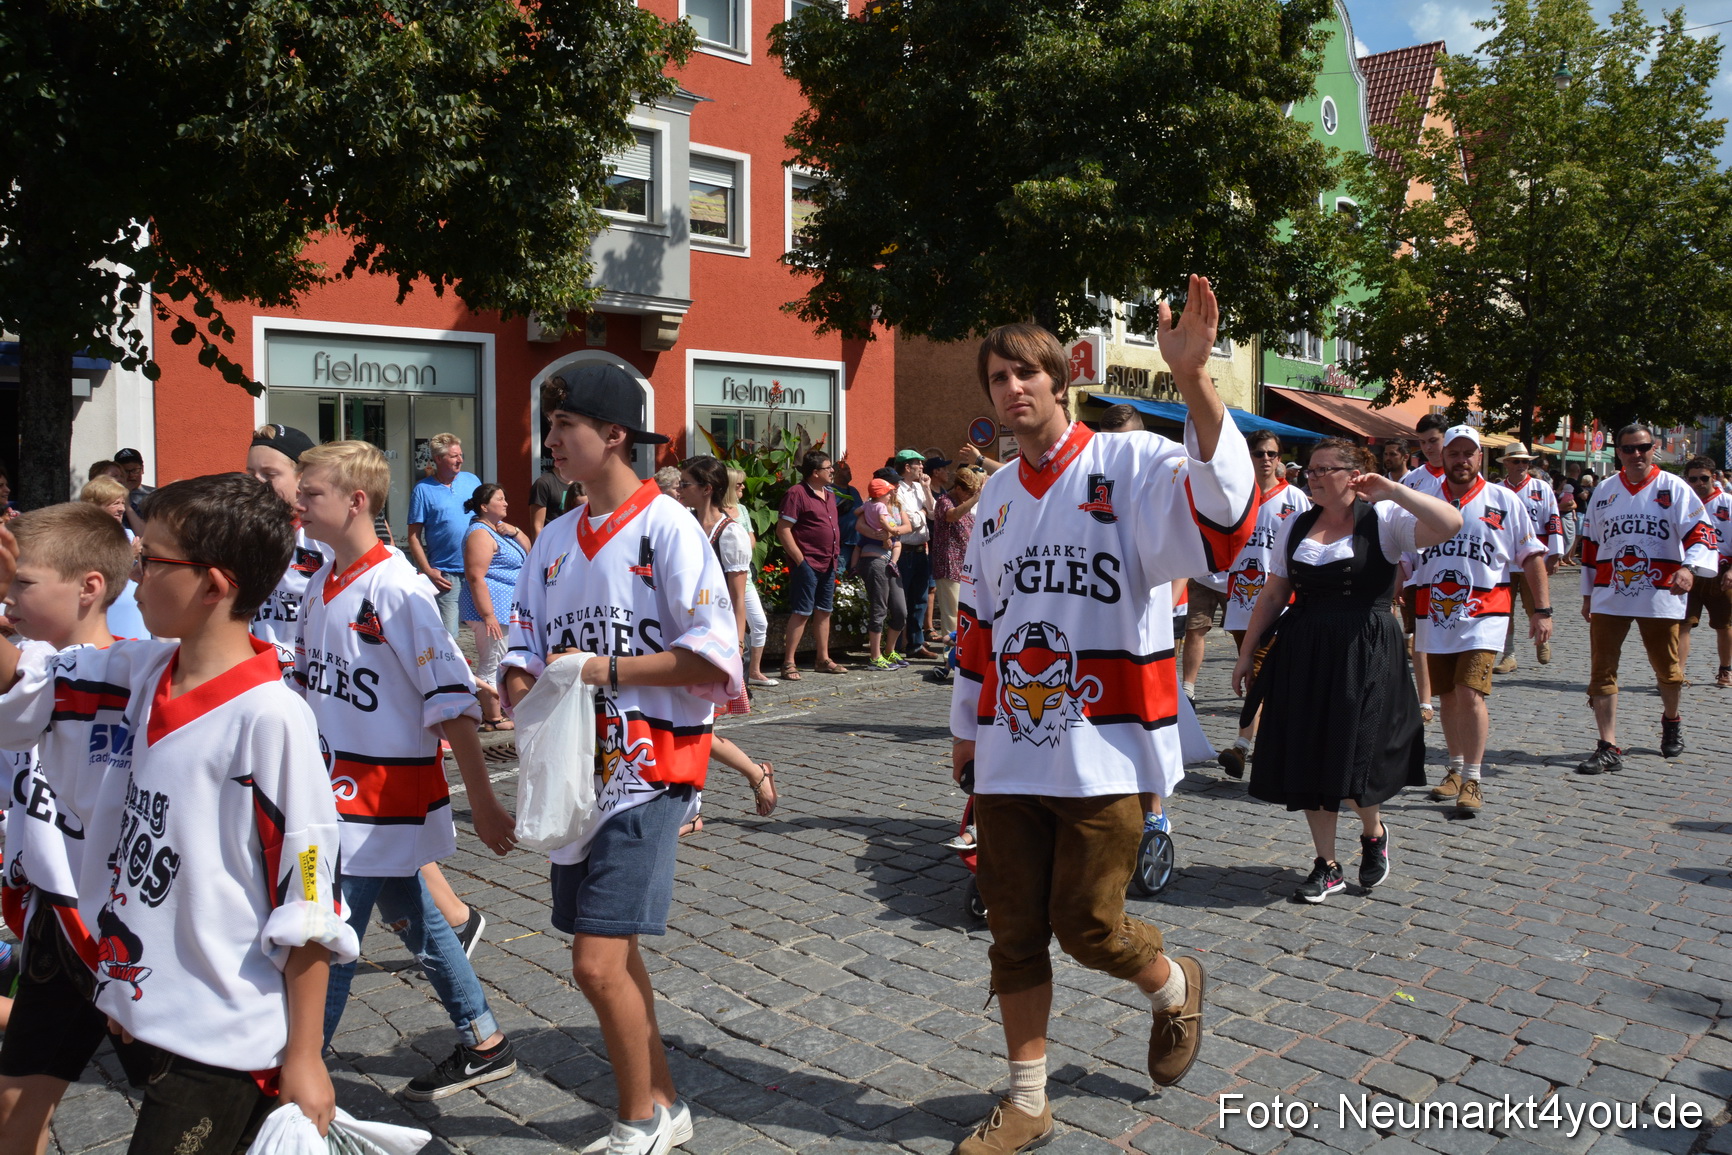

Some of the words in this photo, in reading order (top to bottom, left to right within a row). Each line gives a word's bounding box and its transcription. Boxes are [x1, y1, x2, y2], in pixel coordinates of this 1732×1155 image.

[314, 351, 437, 386] fielmann
[1110, 364, 1151, 389] STADT
[1610, 513, 1658, 523] NEUMARKT
[1003, 544, 1087, 574] NEMARKT
[553, 604, 634, 629] NEUMAKT
[307, 661, 380, 713] GLES
